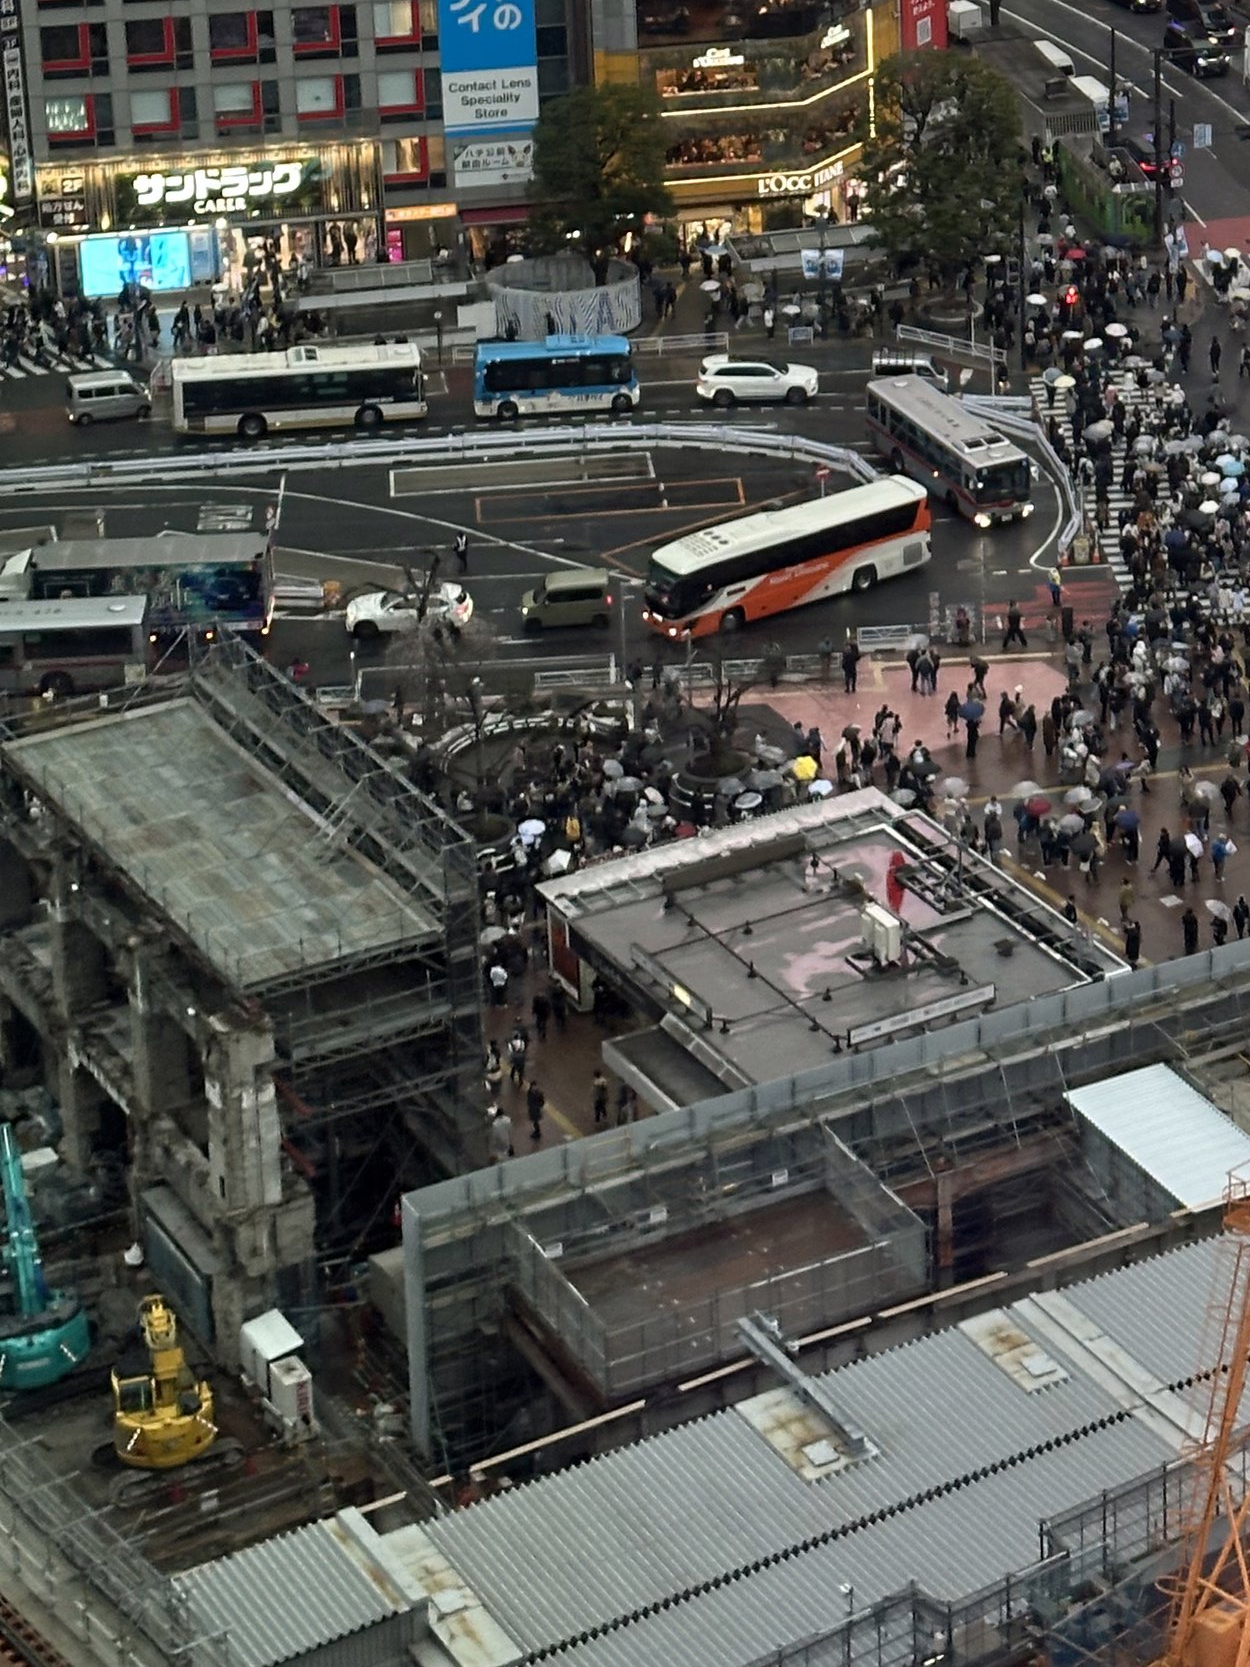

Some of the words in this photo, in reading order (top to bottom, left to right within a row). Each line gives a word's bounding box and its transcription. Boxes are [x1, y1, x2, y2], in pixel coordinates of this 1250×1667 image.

[449, 80, 497, 94] Contact
[501, 78, 532, 90] Lens
[461, 94, 520, 108] Speciality
[474, 108, 508, 120] Store
[62, 179, 82, 194] 2F
[133, 163, 303, 205] サンドラッグ
